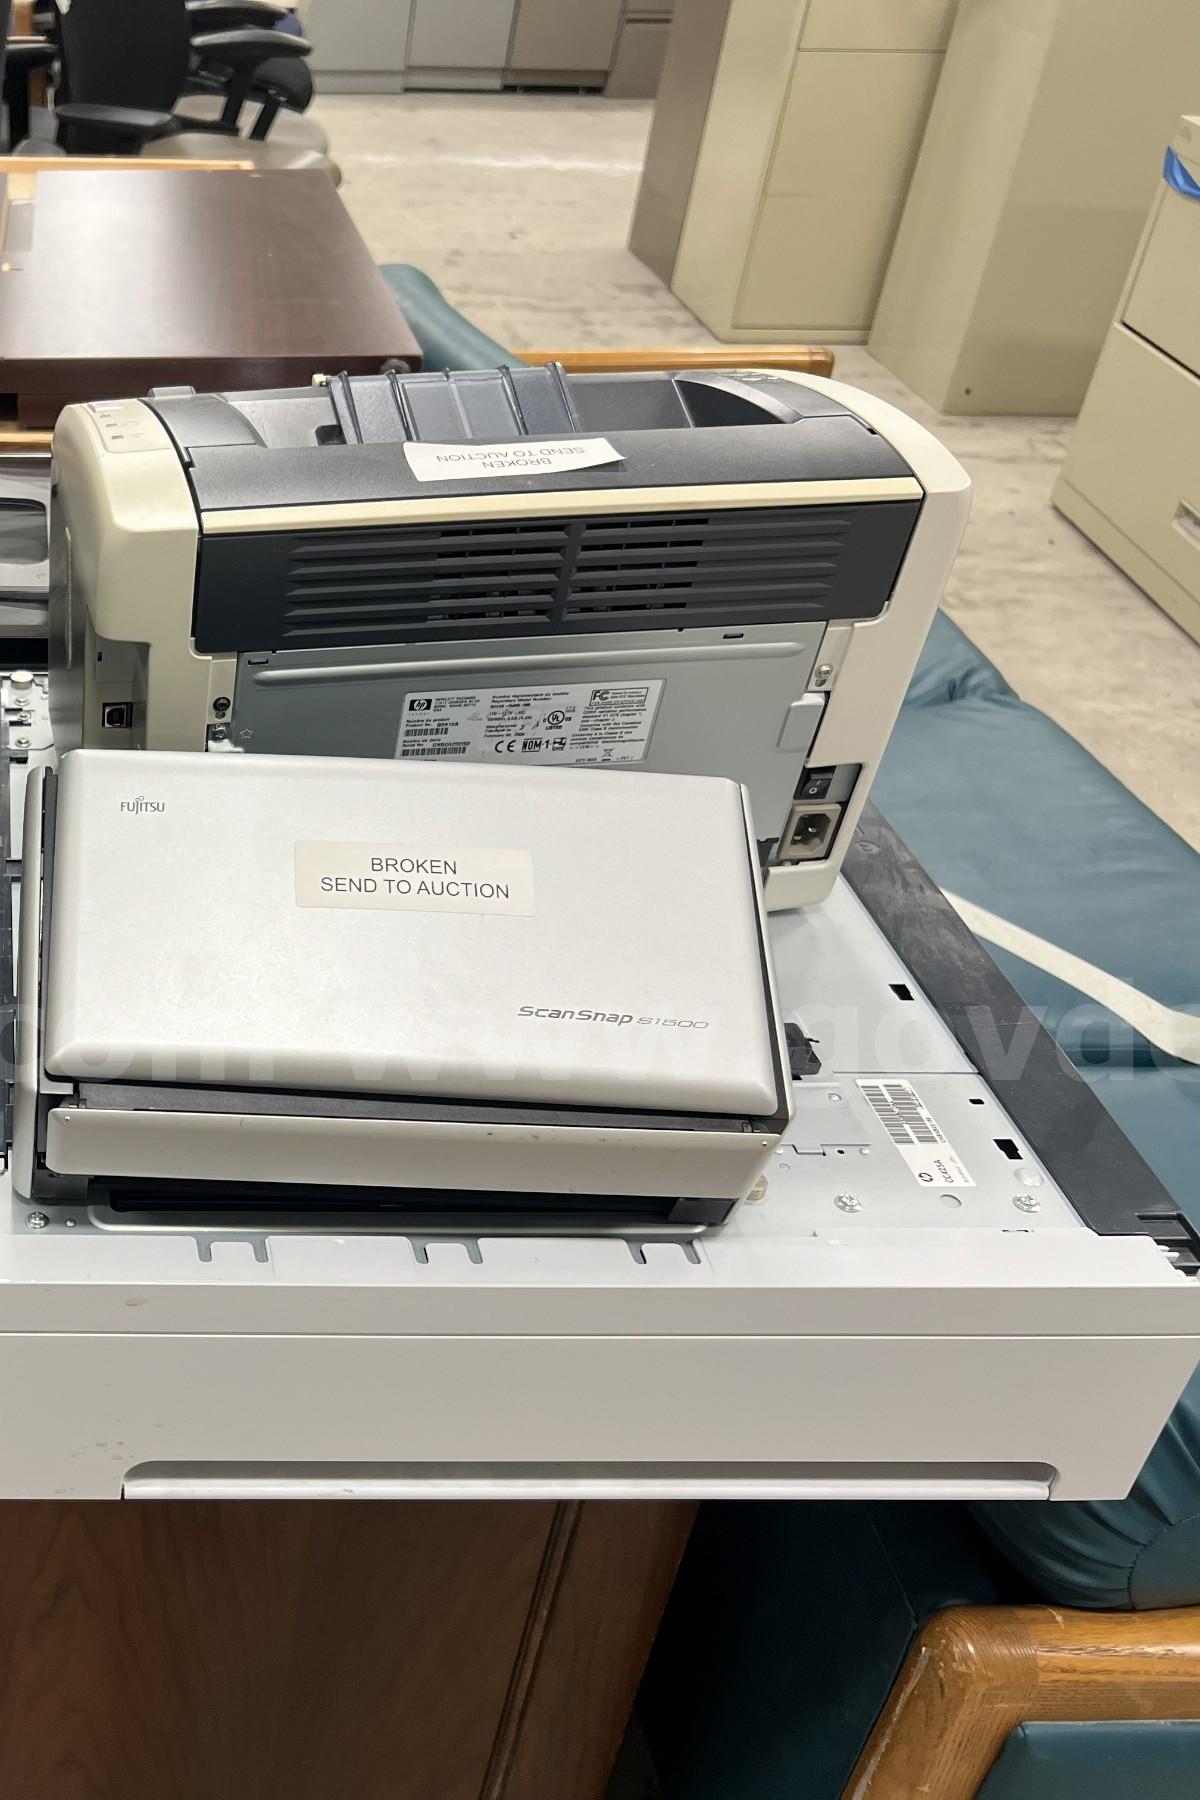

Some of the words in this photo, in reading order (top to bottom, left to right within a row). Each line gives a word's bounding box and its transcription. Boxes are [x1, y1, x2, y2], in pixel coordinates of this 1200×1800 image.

[436, 450, 509, 463] AUCTION
[513, 449, 537, 458] TO
[540, 447, 585, 457] SEND
[483, 457, 552, 469] BROKEN
[495, 740, 516, 753] CE
[120, 796, 166, 815] FUJITSU
[370, 857, 458, 876] BROKEN
[320, 876, 378, 894] SEND
[383, 879, 413, 895] TO
[416, 881, 511, 900] AUCTION
[517, 1005, 634, 1026] ScanSnap
[637, 1017, 709, 1029] S1500
